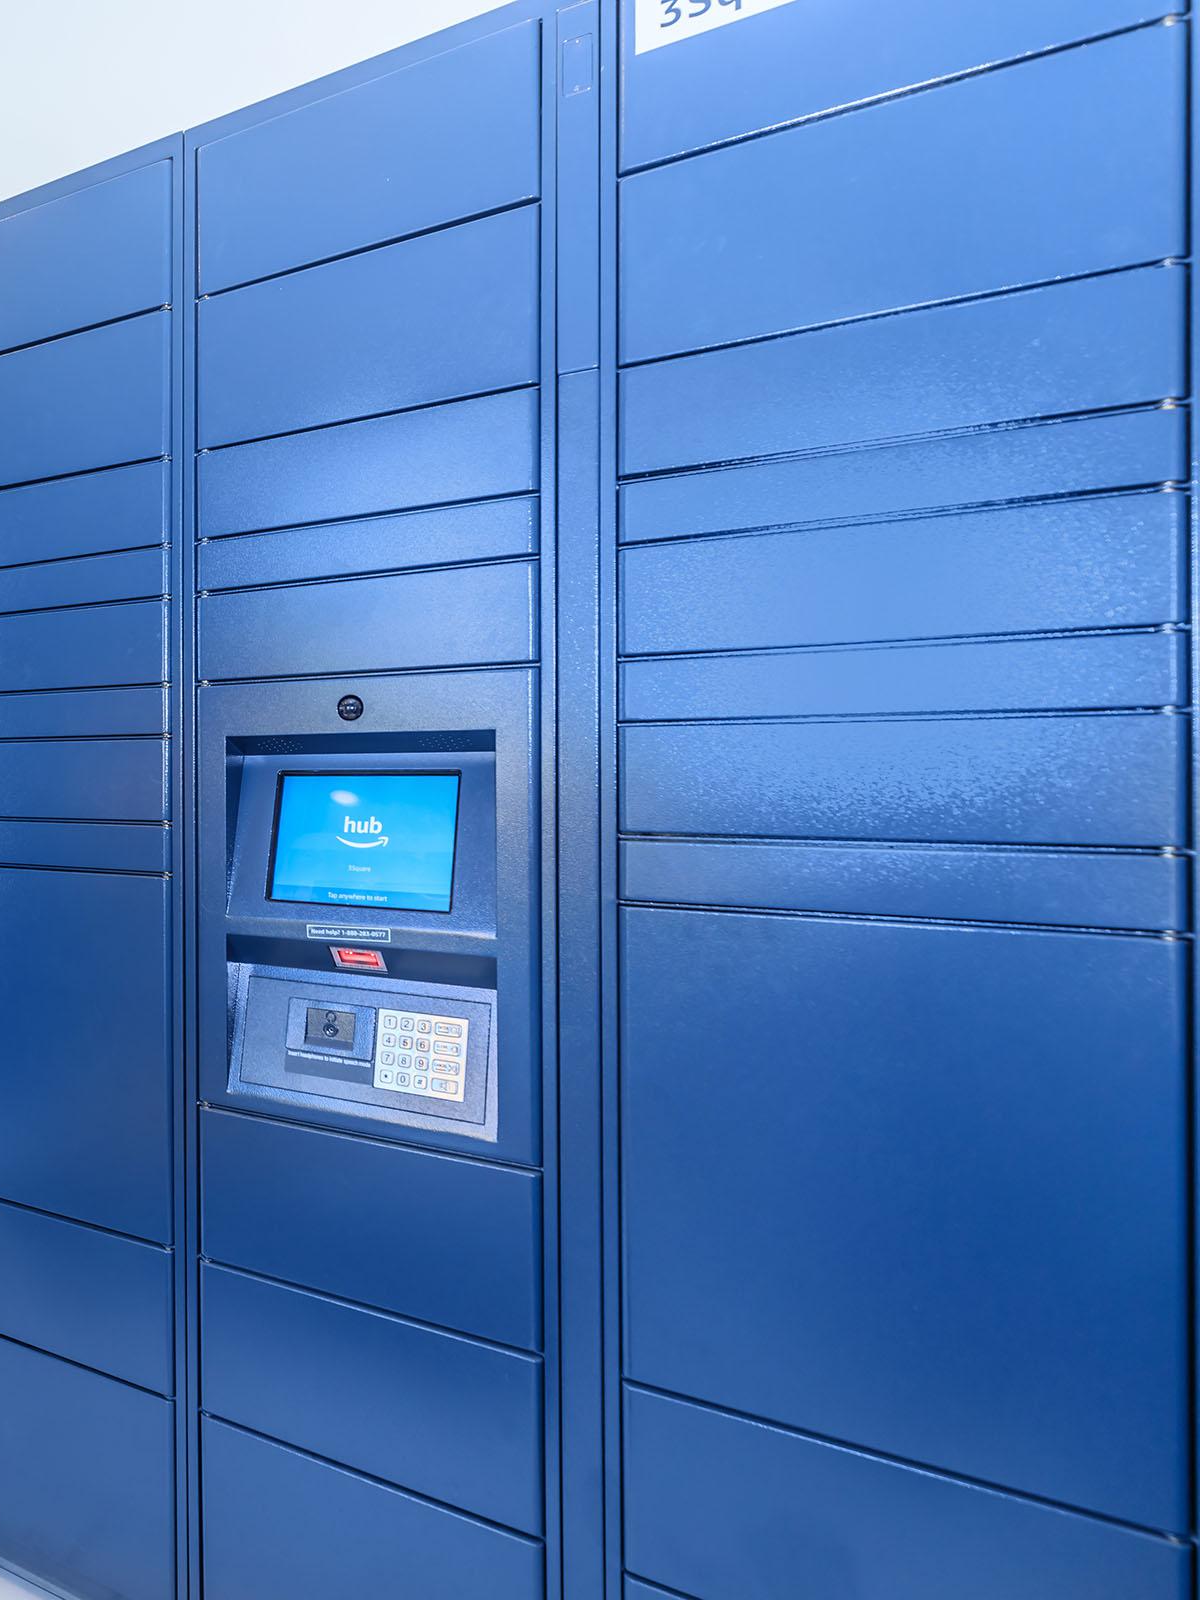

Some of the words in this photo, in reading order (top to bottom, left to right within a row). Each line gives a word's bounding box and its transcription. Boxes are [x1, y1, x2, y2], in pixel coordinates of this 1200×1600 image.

[343, 815, 383, 834] hub
[328, 891, 338, 900] Tap
[338, 893, 365, 901] anywhere
[310, 927, 324, 935] Need
[420, 1023, 427, 1031] 3
[385, 1036, 391, 1044] 4
[402, 1039, 408, 1047] 5
[419, 1041, 426, 1049] 6
[384, 1054, 390, 1062] 7
[400, 1056, 407, 1065] 8
[418, 1059, 424, 1068] 9
[399, 1075, 406, 1084] 0
